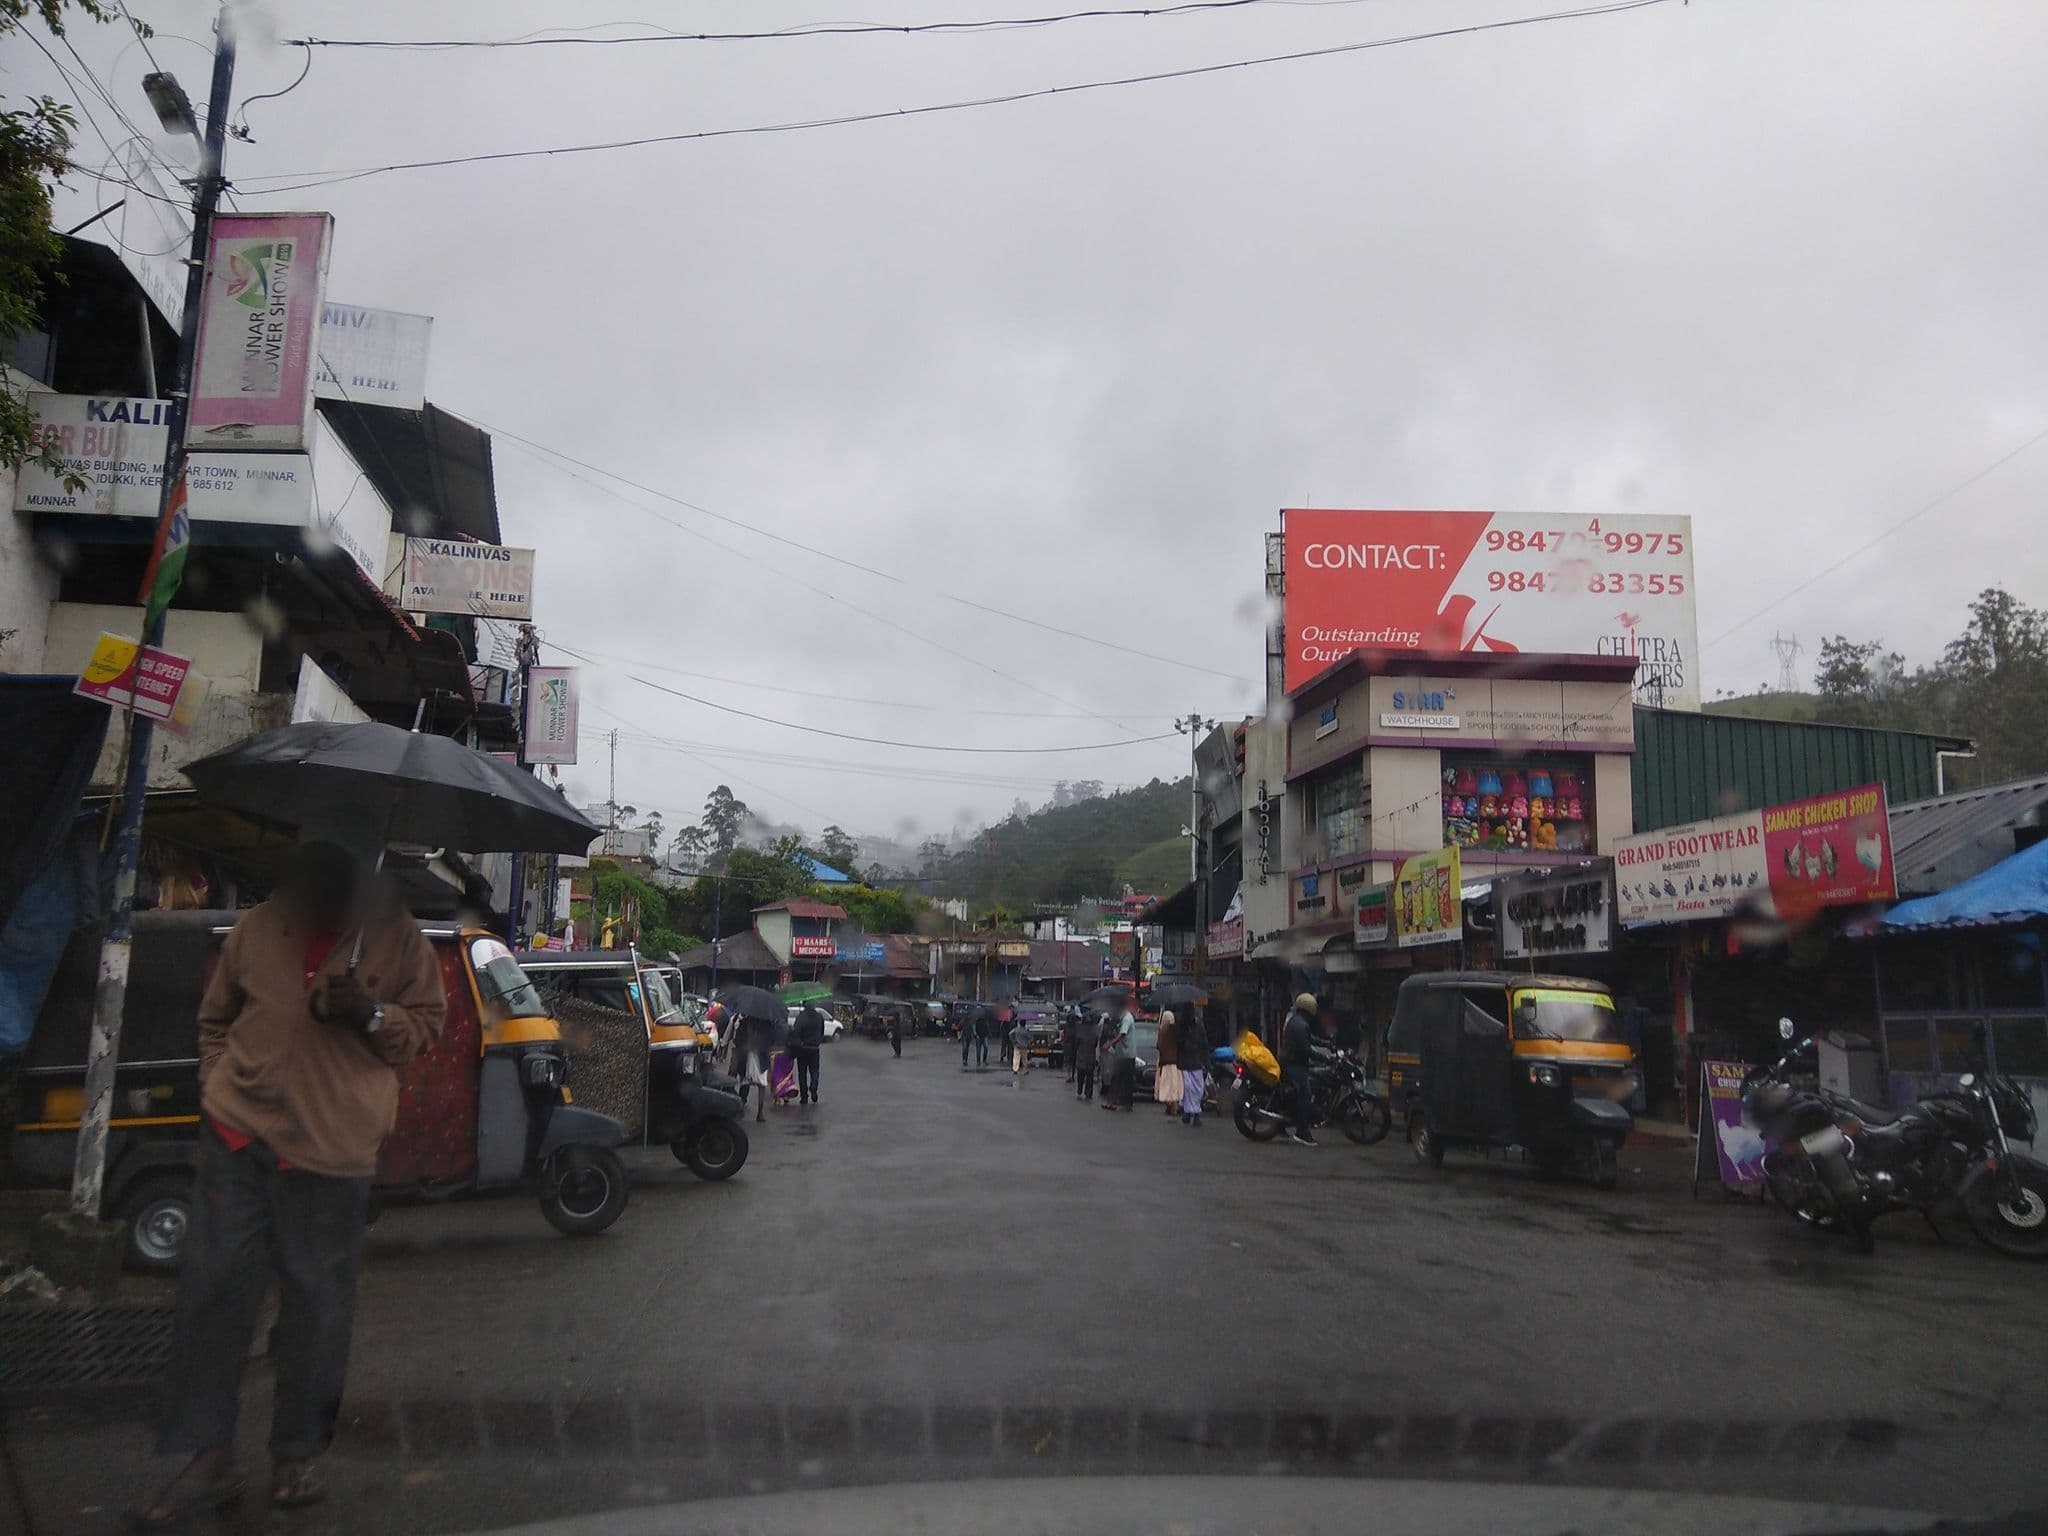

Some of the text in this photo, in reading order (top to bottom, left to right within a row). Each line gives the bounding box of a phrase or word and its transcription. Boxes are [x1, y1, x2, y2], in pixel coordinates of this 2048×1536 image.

[269, 263, 289, 316] SHOW
[94, 460, 149, 474] BUILDING,
[205, 467, 240, 480] TOWN,
[246, 471, 297, 483] MUNNAR,
[96, 473, 138, 487] IDUKKI,
[194, 478, 213, 490] 685
[215, 480, 233, 491] 612
[27, 494, 76, 507] MUNNAR
[430, 542, 511, 561] KALINIVAS
[1303, 543, 1447, 570] CONTACT:
[489, 593, 525, 603] HERE
[1301, 626, 1422, 647] Outstanding
[1597, 629, 1683, 663] CHITRA
[1635, 663, 1684, 688] TERS
[560, 688, 568, 712] SHOW
[549, 707, 558, 741] MUNNAR
[557, 713, 567, 741] FLOWER
[1387, 715, 1454, 726] WATCHHOUSE
[1805, 797, 1847, 825] CHICKEN
[1850, 791, 1878, 817] SHOP
[1618, 843, 1665, 866] GRAND
[1668, 825, 1759, 858] FOOTWEAR
[1676, 899, 1705, 911] Bata
[799, 946, 832, 955] MEDICALS
